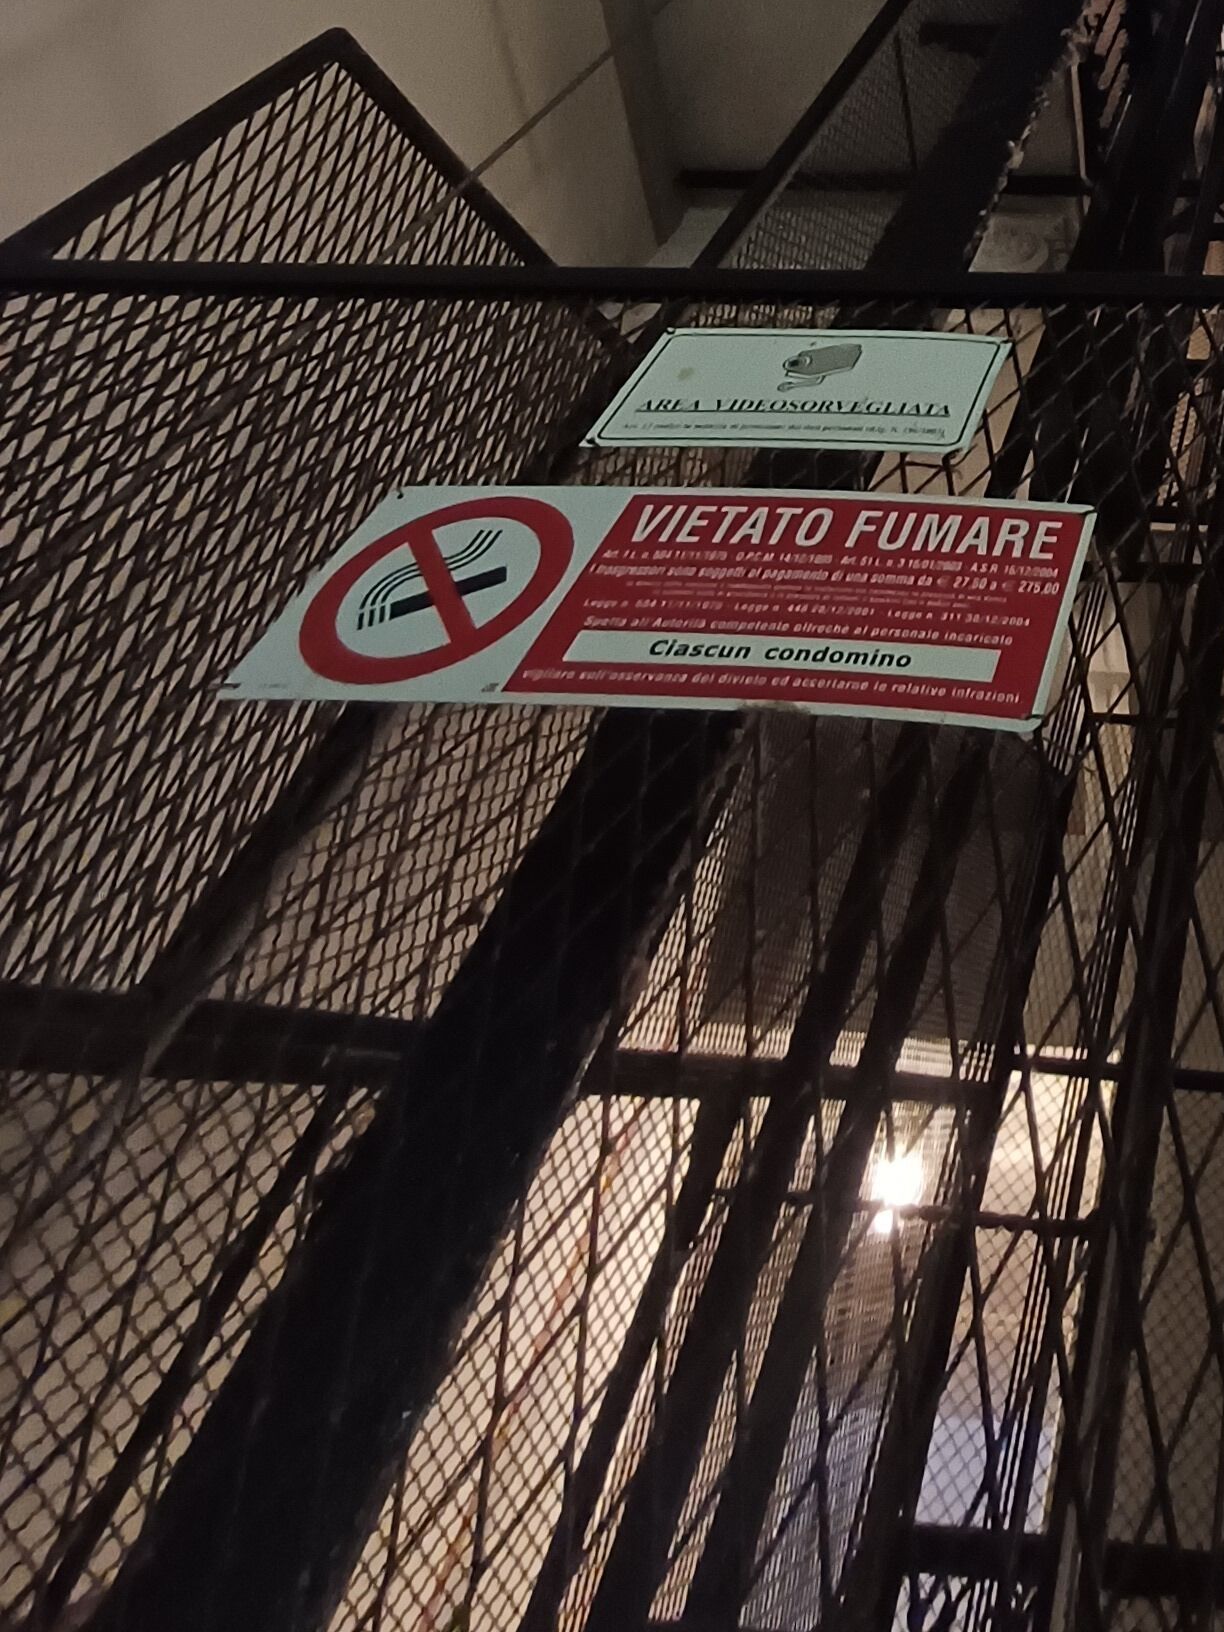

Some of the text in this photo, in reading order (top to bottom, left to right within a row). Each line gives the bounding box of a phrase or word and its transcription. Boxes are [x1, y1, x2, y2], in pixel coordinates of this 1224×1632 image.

[636, 398, 951, 417] AREA VIDEOSORVEGLIATA
[631, 504, 1063, 560] VIETATO FUMARE
[761, 567, 829, 582] pagamento
[845, 572, 869, 582] una
[870, 573, 915, 585] somma
[1017, 579, 1060, 595] 275,00
[583, 598, 617, 608] Legge
[733, 602, 768, 613] Legge
[886, 609, 922, 620] Legge
[709, 620, 789, 634] competente
[853, 625, 868, 634] al
[869, 627, 939, 640] personale
[943, 631, 1013, 646] incaricato
[649, 639, 912, 668] Ciascun condomino
[690, 673, 714, 683] del
[717, 674, 768, 685] divieto
[770, 677, 789, 686] ed
[791, 678, 869, 690] accertarne
[872, 682, 887, 692] le
[890, 683, 946, 696] relative
